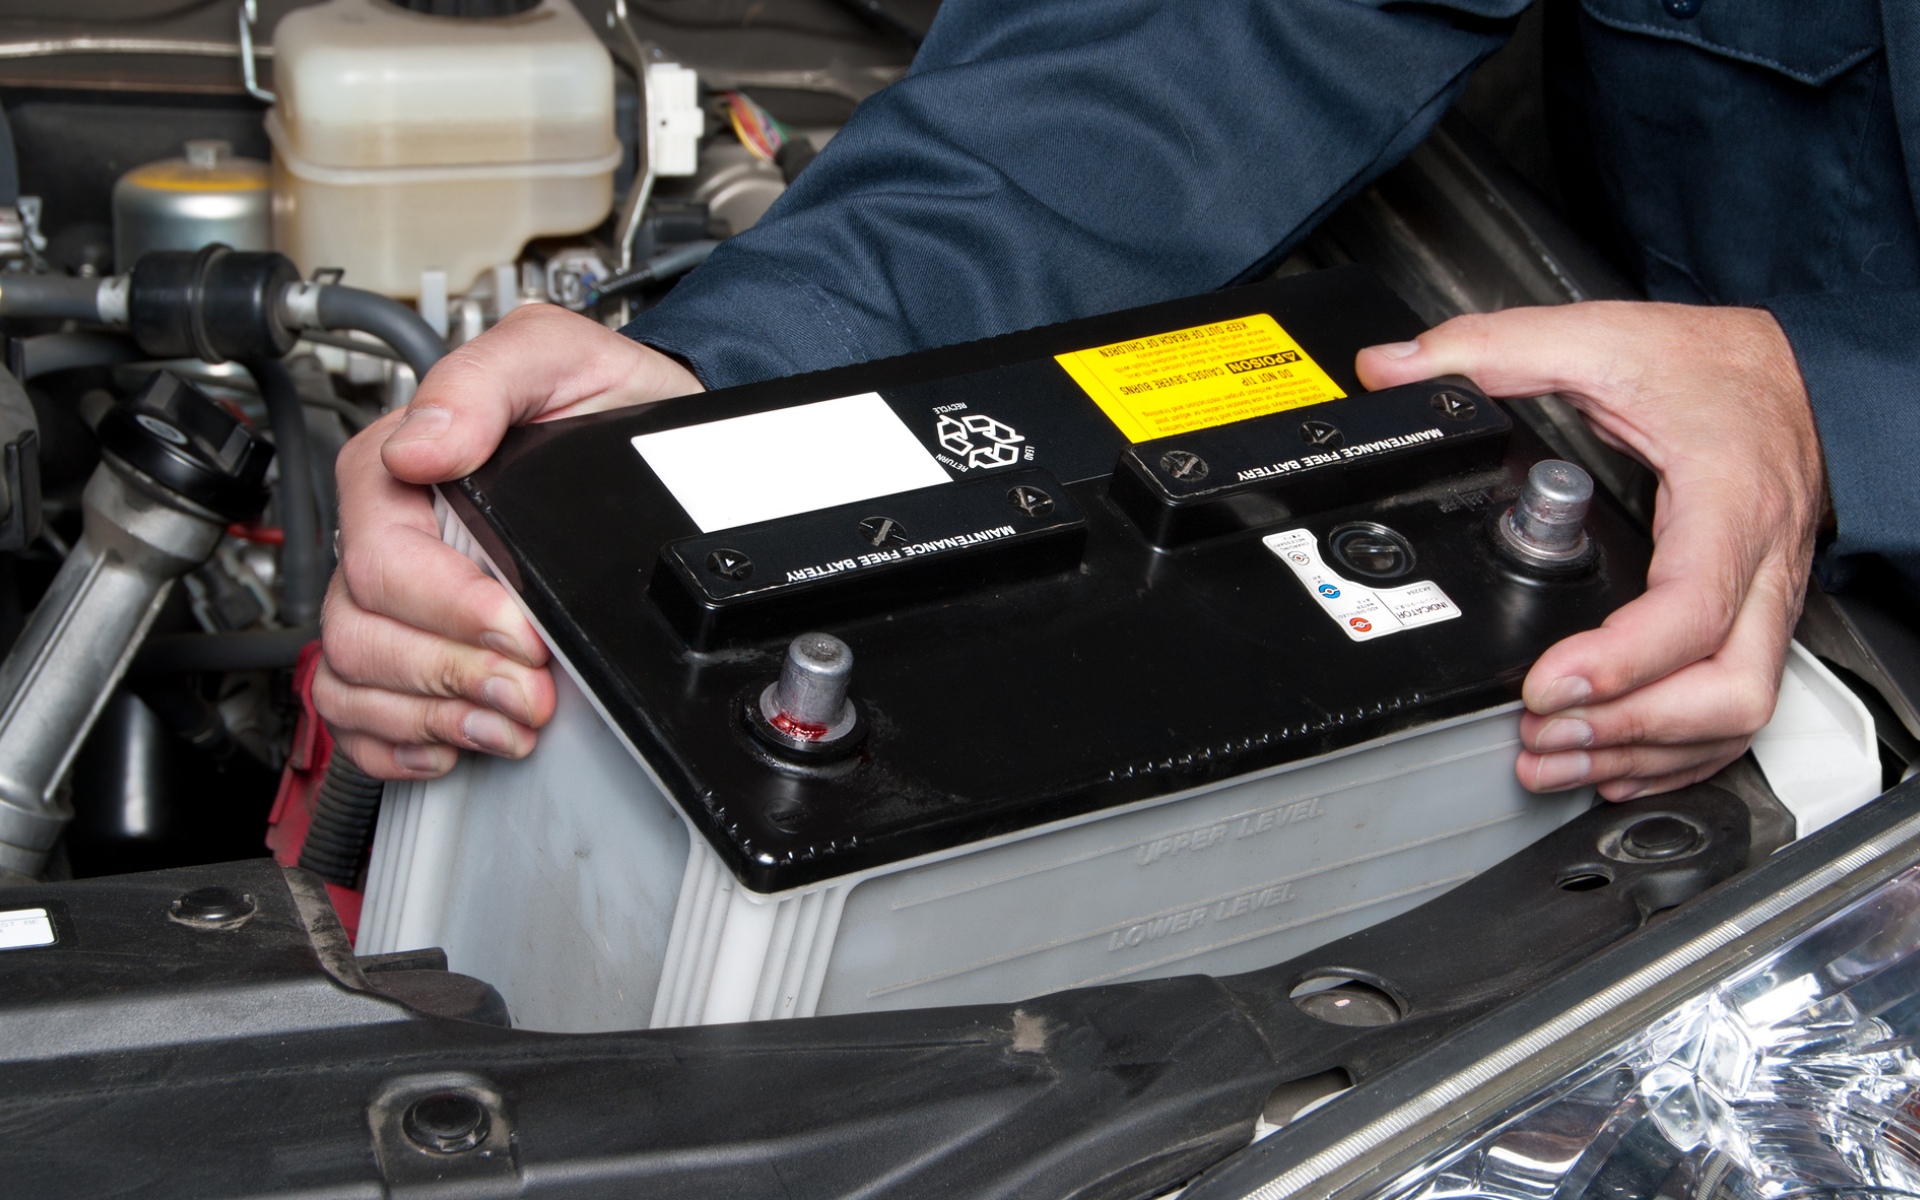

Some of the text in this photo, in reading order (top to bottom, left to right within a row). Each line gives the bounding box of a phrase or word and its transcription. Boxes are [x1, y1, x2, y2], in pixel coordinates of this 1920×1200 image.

[1099, 321, 1248, 357] KEEP OUT OF REACH OF CHILDREN
[1119, 355, 1285, 395] POISON CAUSES SEVERE BURNS
[1242, 369, 1294, 386] DO NOT TIP
[932, 402, 968, 415] RECYCLE
[935, 453, 969, 473] RETURN
[1024, 445, 1035, 461] LEAD
[1238, 428, 1444, 482] MAINTENANCE FREE BATTERY
[786, 525, 1017, 582] MAINTENANCE FREE BATTERY
[1396, 602, 1449, 620] INDICATOR
[1136, 798, 1325, 866] UPPER LEVEL
[1109, 883, 1297, 952] LOWER LEVEL
